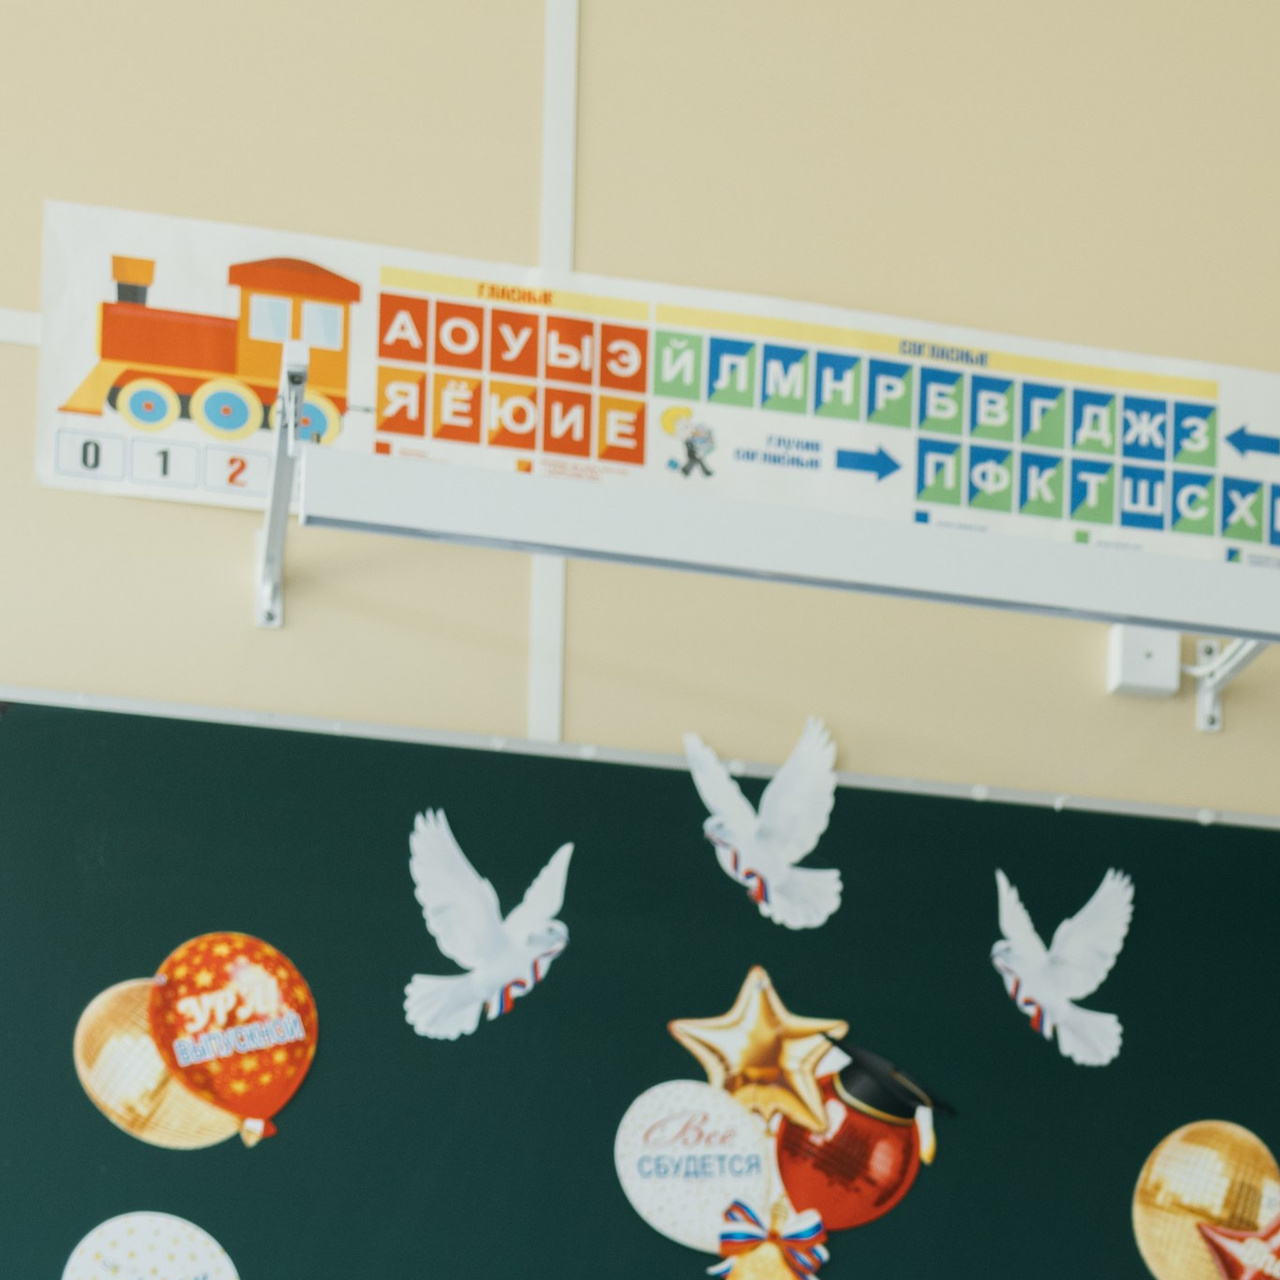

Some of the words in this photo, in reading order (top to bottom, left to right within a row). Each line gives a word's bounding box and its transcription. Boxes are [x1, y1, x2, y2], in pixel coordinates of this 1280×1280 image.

[82, 441, 100, 470] 0
[157, 450, 169, 477] 1
[226, 457, 247, 487] 2
[636, 1153, 762, 1180] СБУДЕТСЯ
